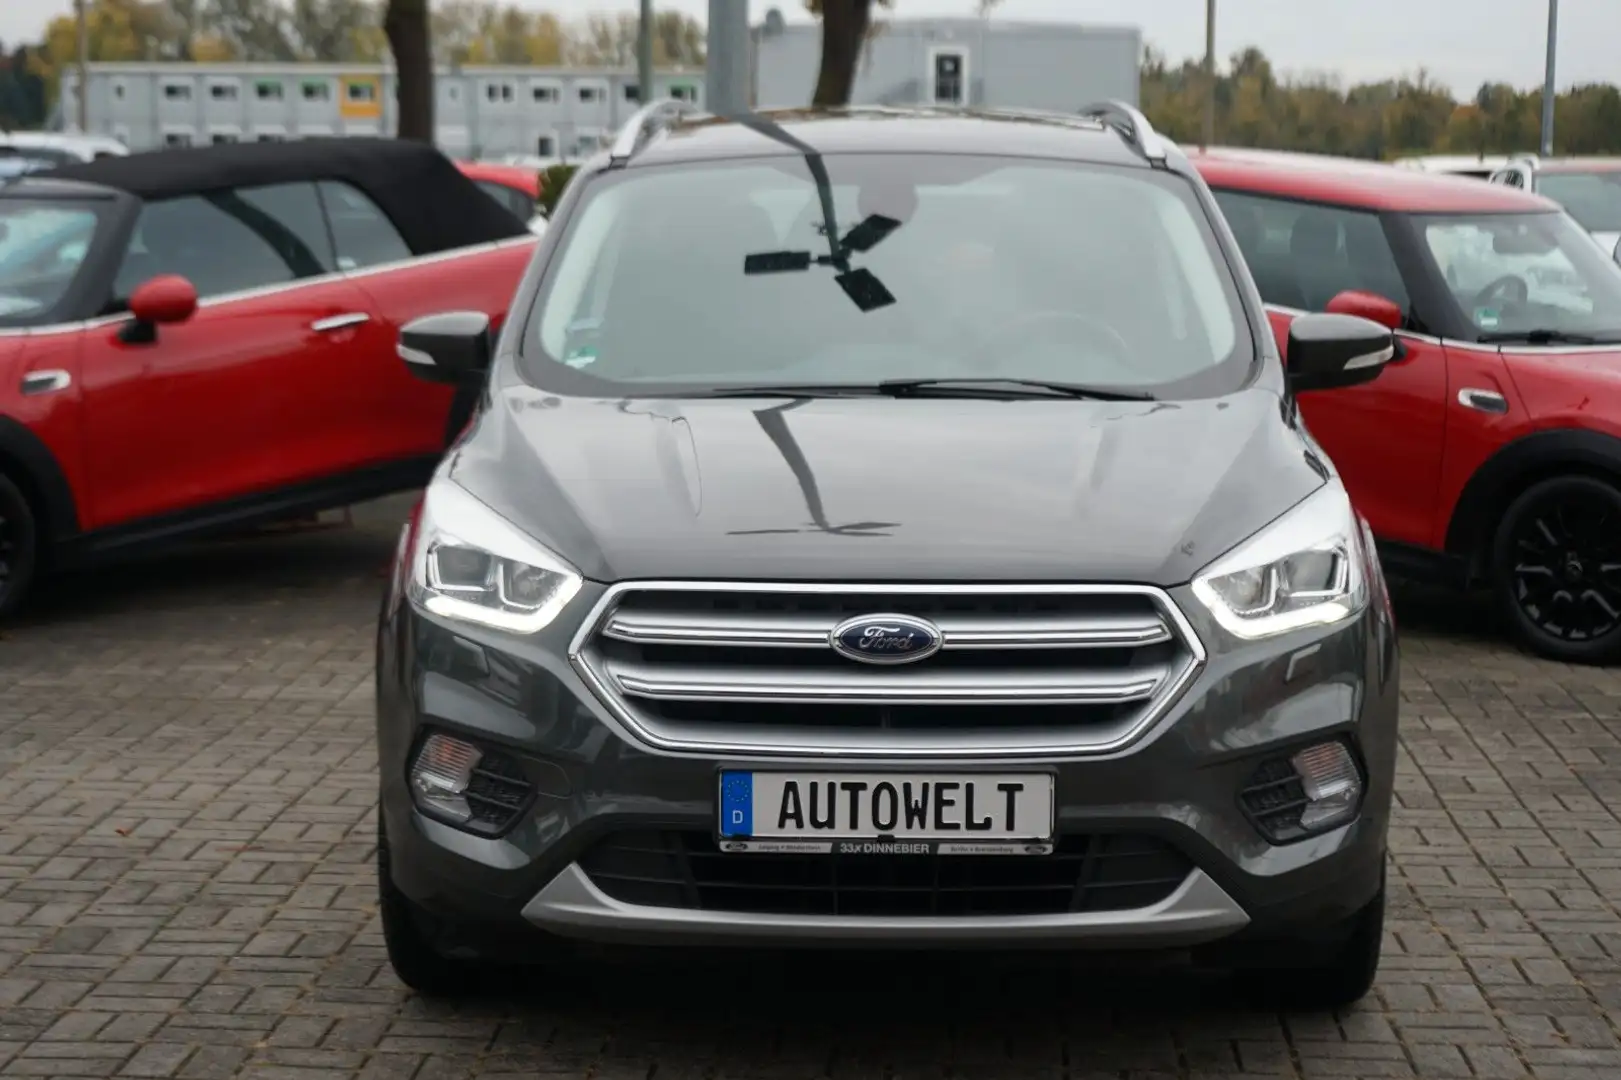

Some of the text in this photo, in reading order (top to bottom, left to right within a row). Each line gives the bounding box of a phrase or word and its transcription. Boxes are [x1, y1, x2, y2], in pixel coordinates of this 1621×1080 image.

[860, 626, 914, 649] Ford
[778, 781, 1023, 831] AUTOWELT
[732, 809, 743, 824] D
[864, 843, 929, 854] DINNEBIER
